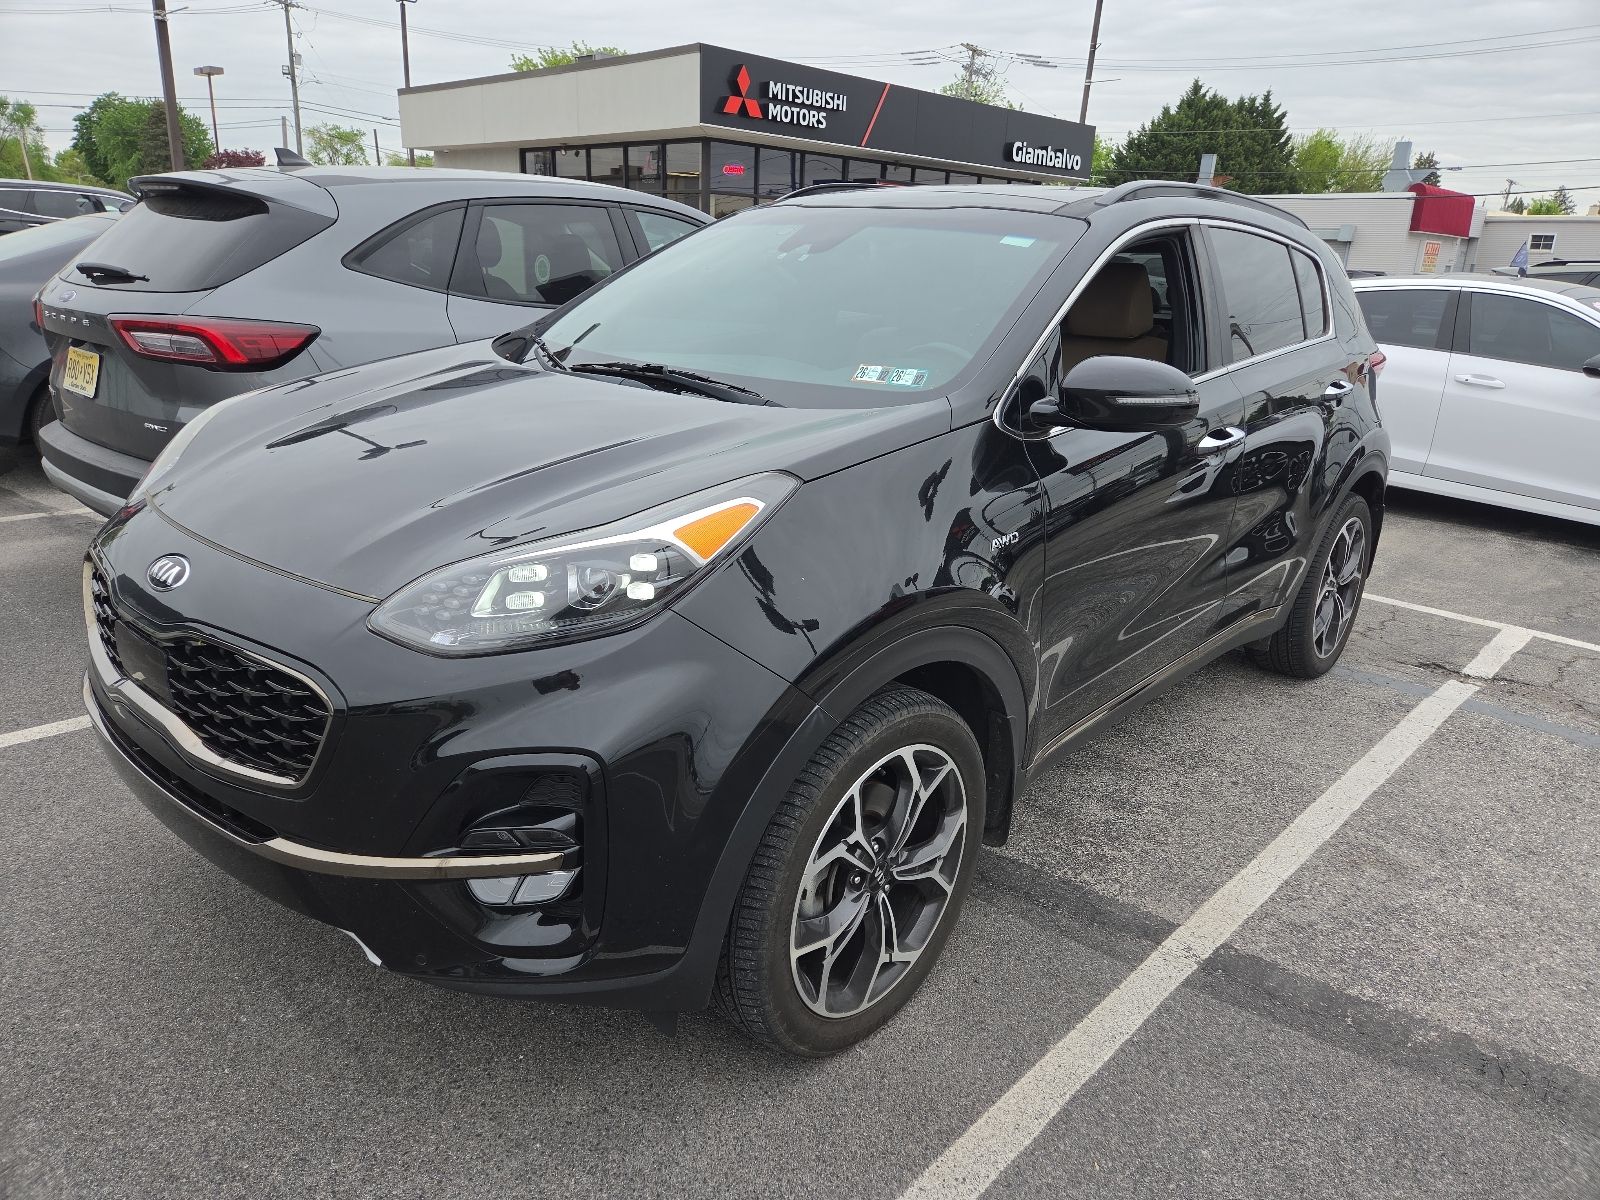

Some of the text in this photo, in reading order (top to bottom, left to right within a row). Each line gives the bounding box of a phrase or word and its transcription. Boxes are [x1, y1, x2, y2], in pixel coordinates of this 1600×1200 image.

[768, 80, 847, 112] MITSUBISHI
[768, 102, 827, 129] MOTORS
[1012, 141, 1082, 171] Giambalvo
[44, 310, 91, 327] SCAPE
[991, 531, 1019, 551] AWD
[149, 558, 182, 586] KIA
